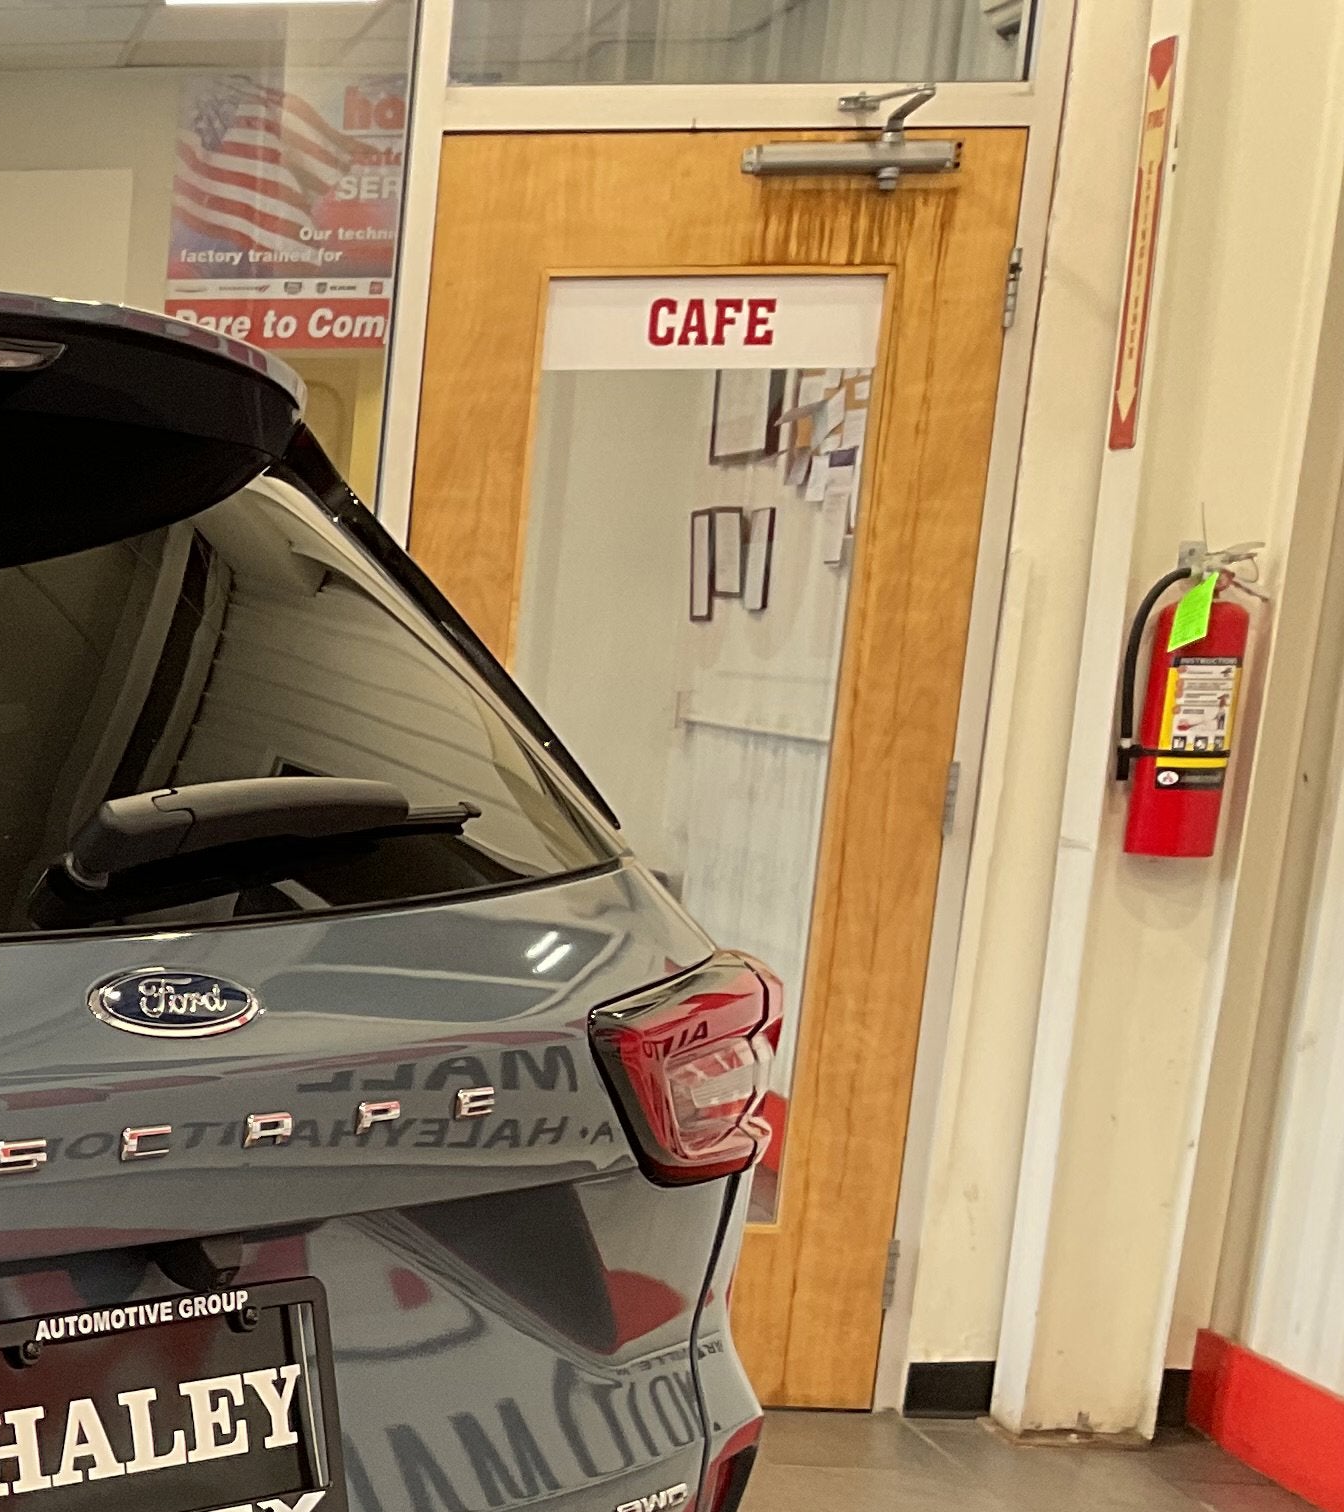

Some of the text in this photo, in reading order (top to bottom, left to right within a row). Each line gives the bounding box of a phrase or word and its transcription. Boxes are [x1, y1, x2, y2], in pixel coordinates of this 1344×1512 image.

[299, 227, 332, 241] Our
[180, 248, 343, 265] factory trained for
[263, 309, 297, 339] to
[307, 307, 389, 344] Com
[647, 298, 778, 347] CAFE
[138, 977, 227, 1018] Ford
[34, 1289, 249, 1342] AUTOMOTIVE GROUP
